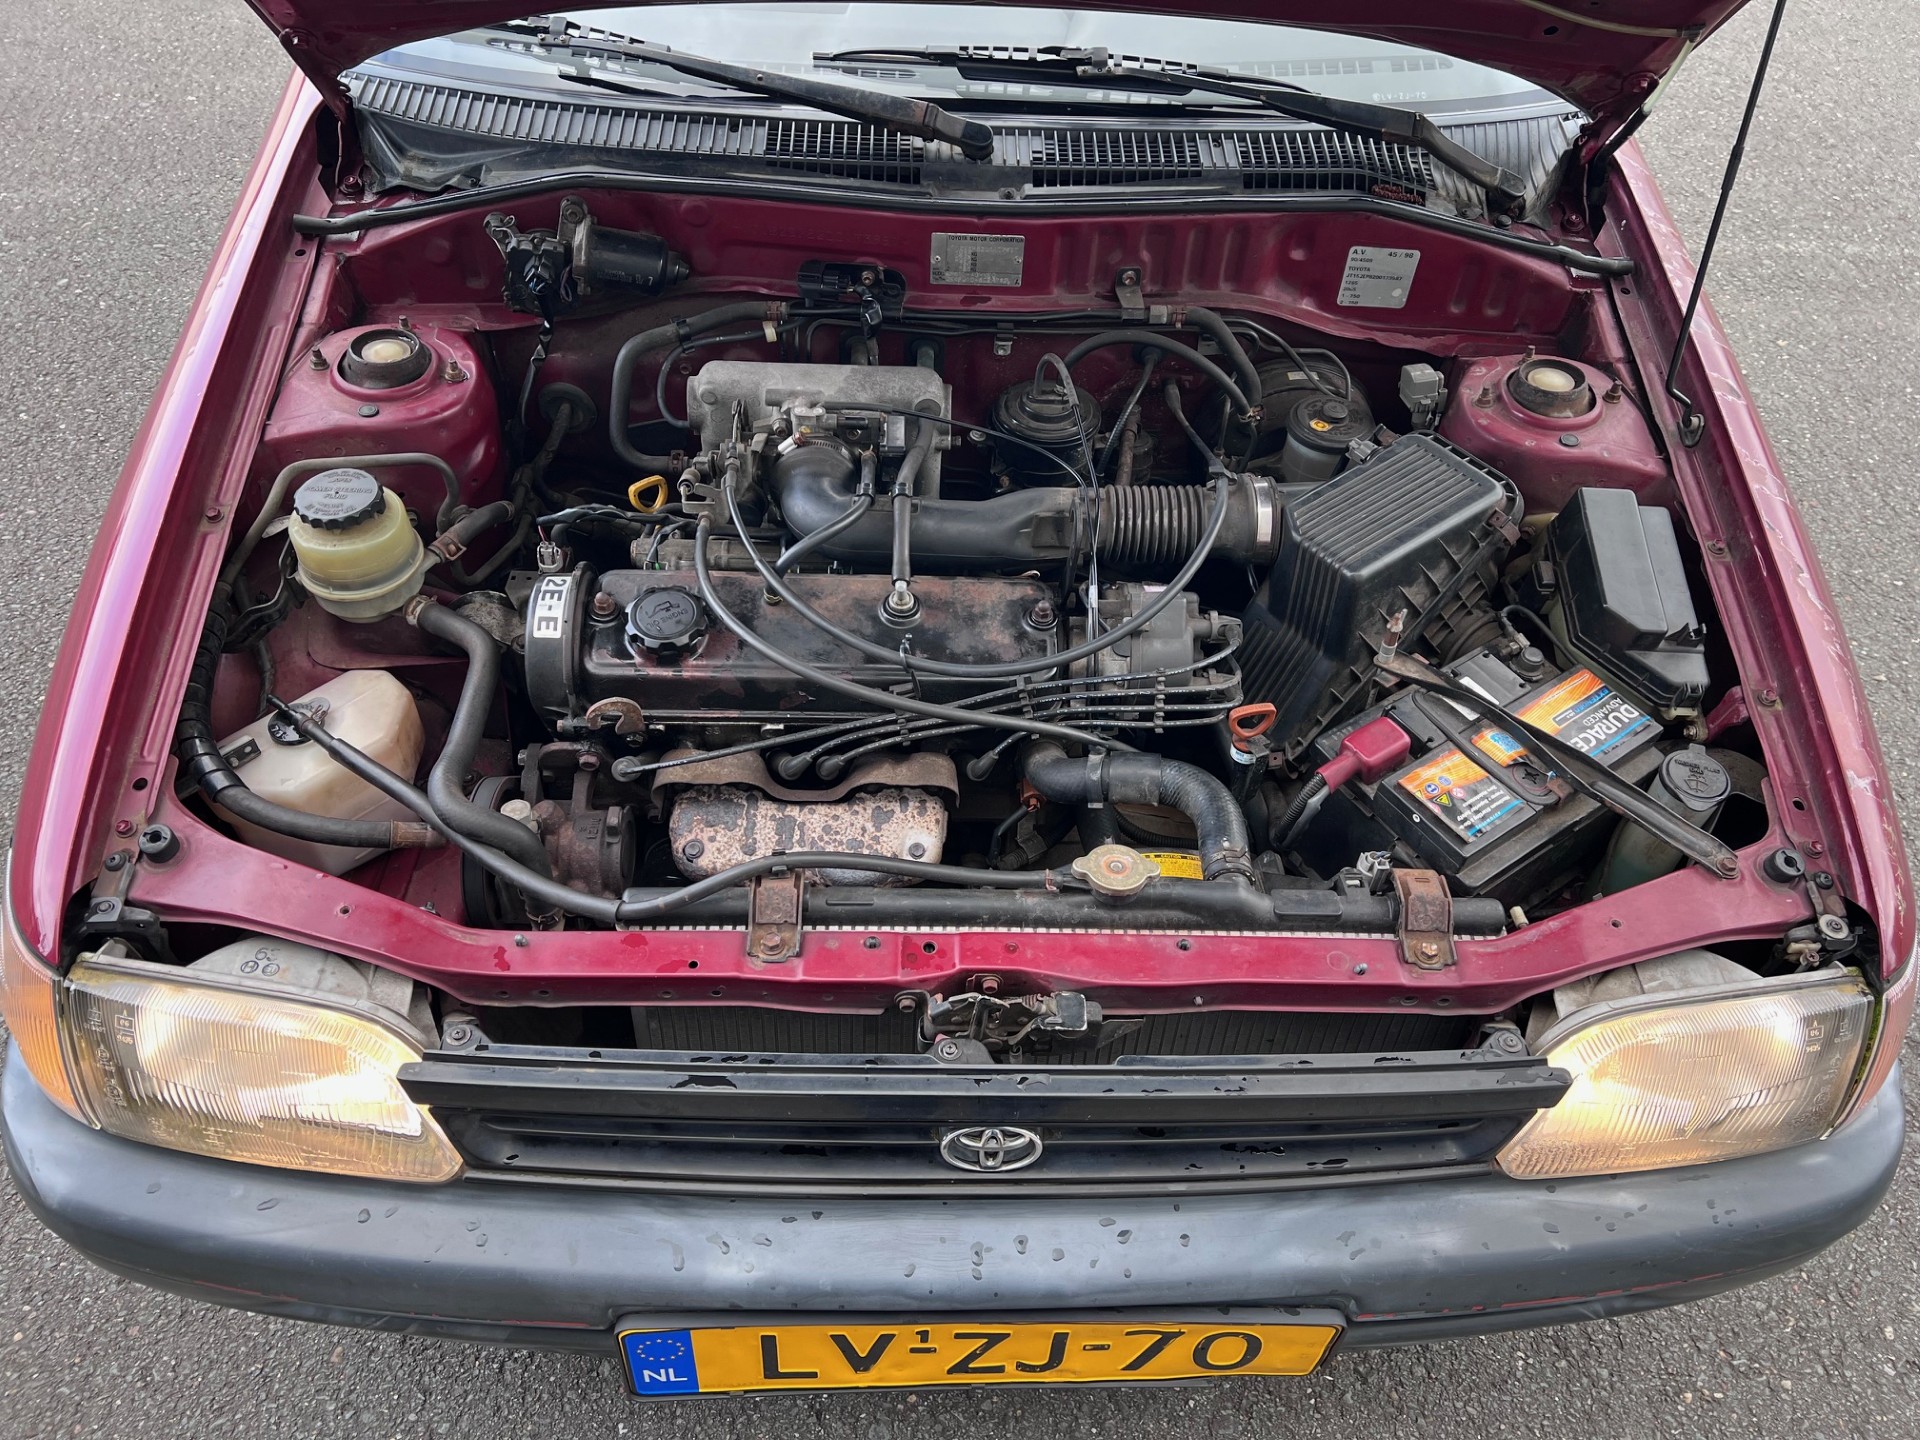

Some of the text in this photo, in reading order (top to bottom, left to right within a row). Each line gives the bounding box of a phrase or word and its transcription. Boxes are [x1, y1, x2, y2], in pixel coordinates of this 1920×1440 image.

[536, 578, 567, 634] 2E-E
[1567, 704, 1640, 752] DURACE
[1582, 698, 1622, 726] ADVANCED
[643, 1368, 688, 1382] NL
[760, 1330, 1263, 1379] LV-ZJ-70
